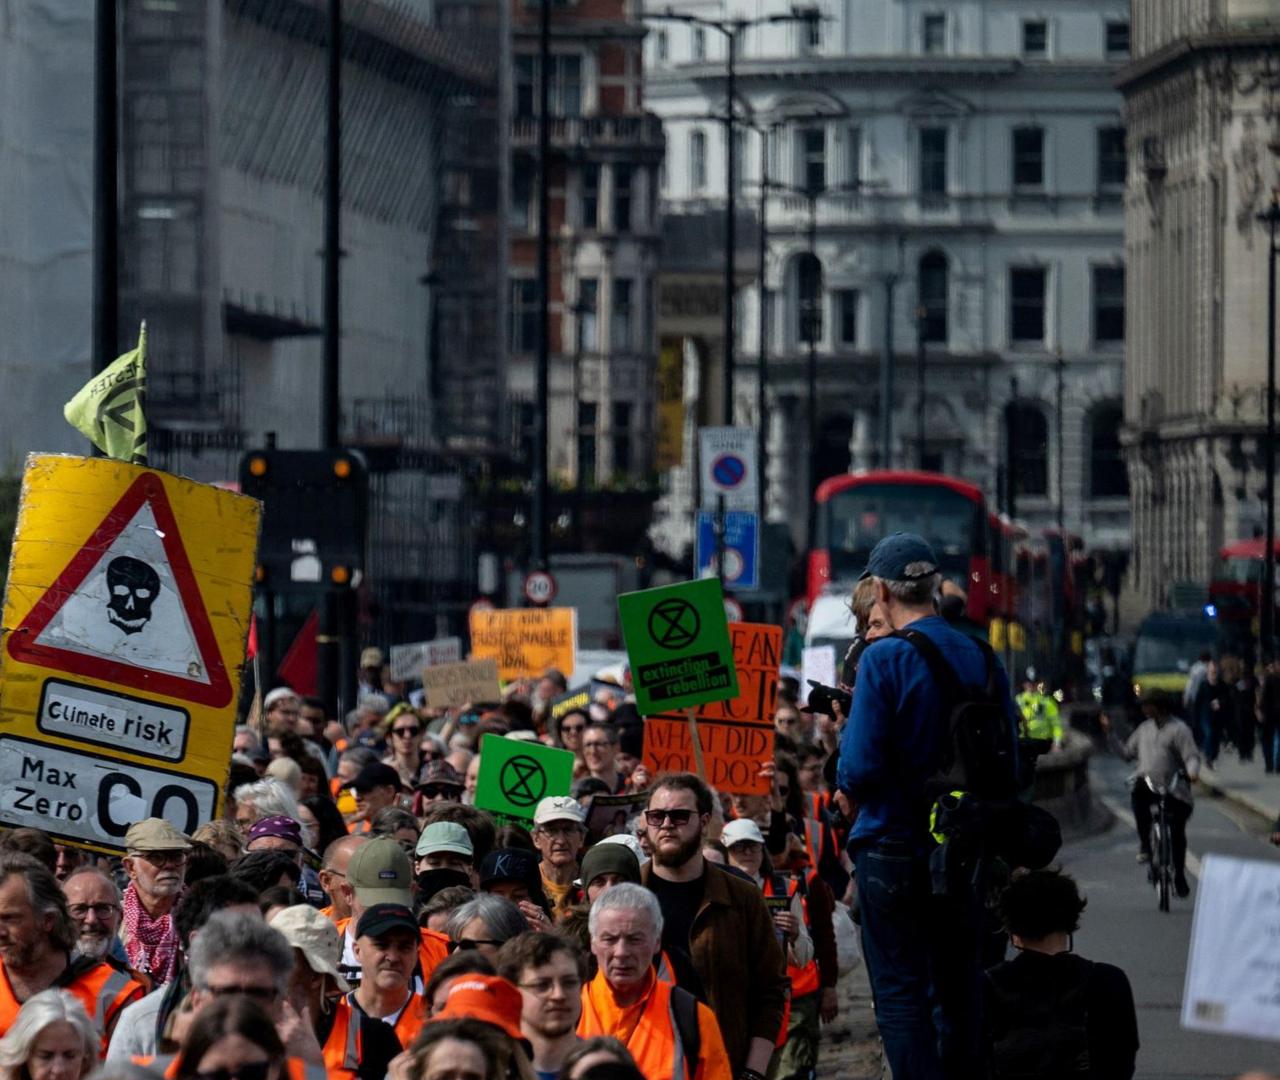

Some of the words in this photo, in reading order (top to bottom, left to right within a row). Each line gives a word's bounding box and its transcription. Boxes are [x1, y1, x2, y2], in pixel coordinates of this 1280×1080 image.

[732, 630, 780, 667] EAN
[642, 658, 710, 682] extinction
[665, 673, 729, 696] rebellion
[47, 701, 116, 732] Climate
[123, 715, 173, 745] risk
[725, 729, 767, 756] DID
[20, 757, 77, 789] Max
[712, 757, 763, 788] DO?
[13, 786, 82, 821] Zero
[97, 772, 200, 838] CO
